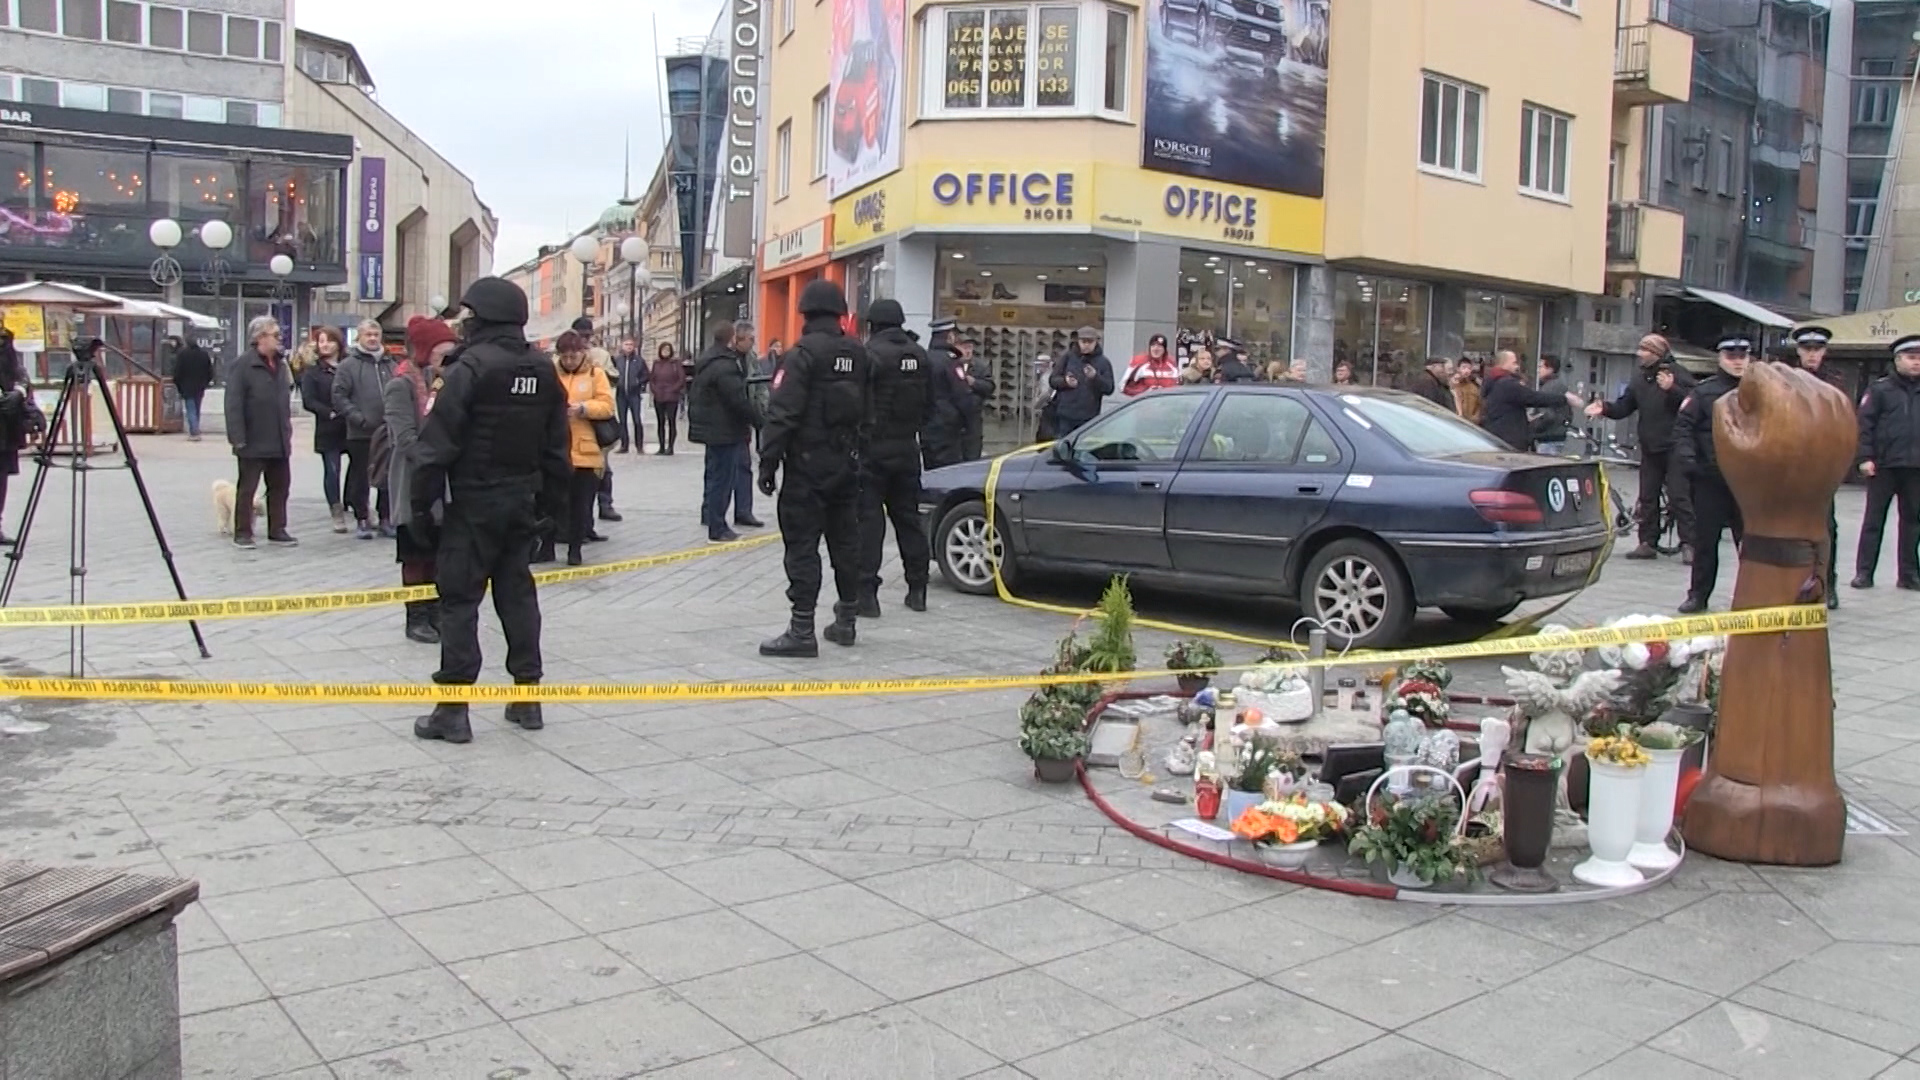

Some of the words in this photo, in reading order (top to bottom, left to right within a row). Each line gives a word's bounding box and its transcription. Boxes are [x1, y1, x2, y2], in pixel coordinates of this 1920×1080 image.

[954, 25, 1026, 42] IZDAJE
[1046, 25, 1069, 40] SE
[959, 57, 1064, 72] PROSTOR
[948, 79, 980, 94] 065
[990, 78, 1020, 94] 001
[1039, 77, 1069, 93] 133
[1, 109, 32, 124] BAR
[1154, 138, 1211, 158] PORSCHE
[933, 173, 1073, 205] OFFICE
[1024, 208, 1073, 221] SHOES
[1164, 185, 1257, 228] OFFICE
